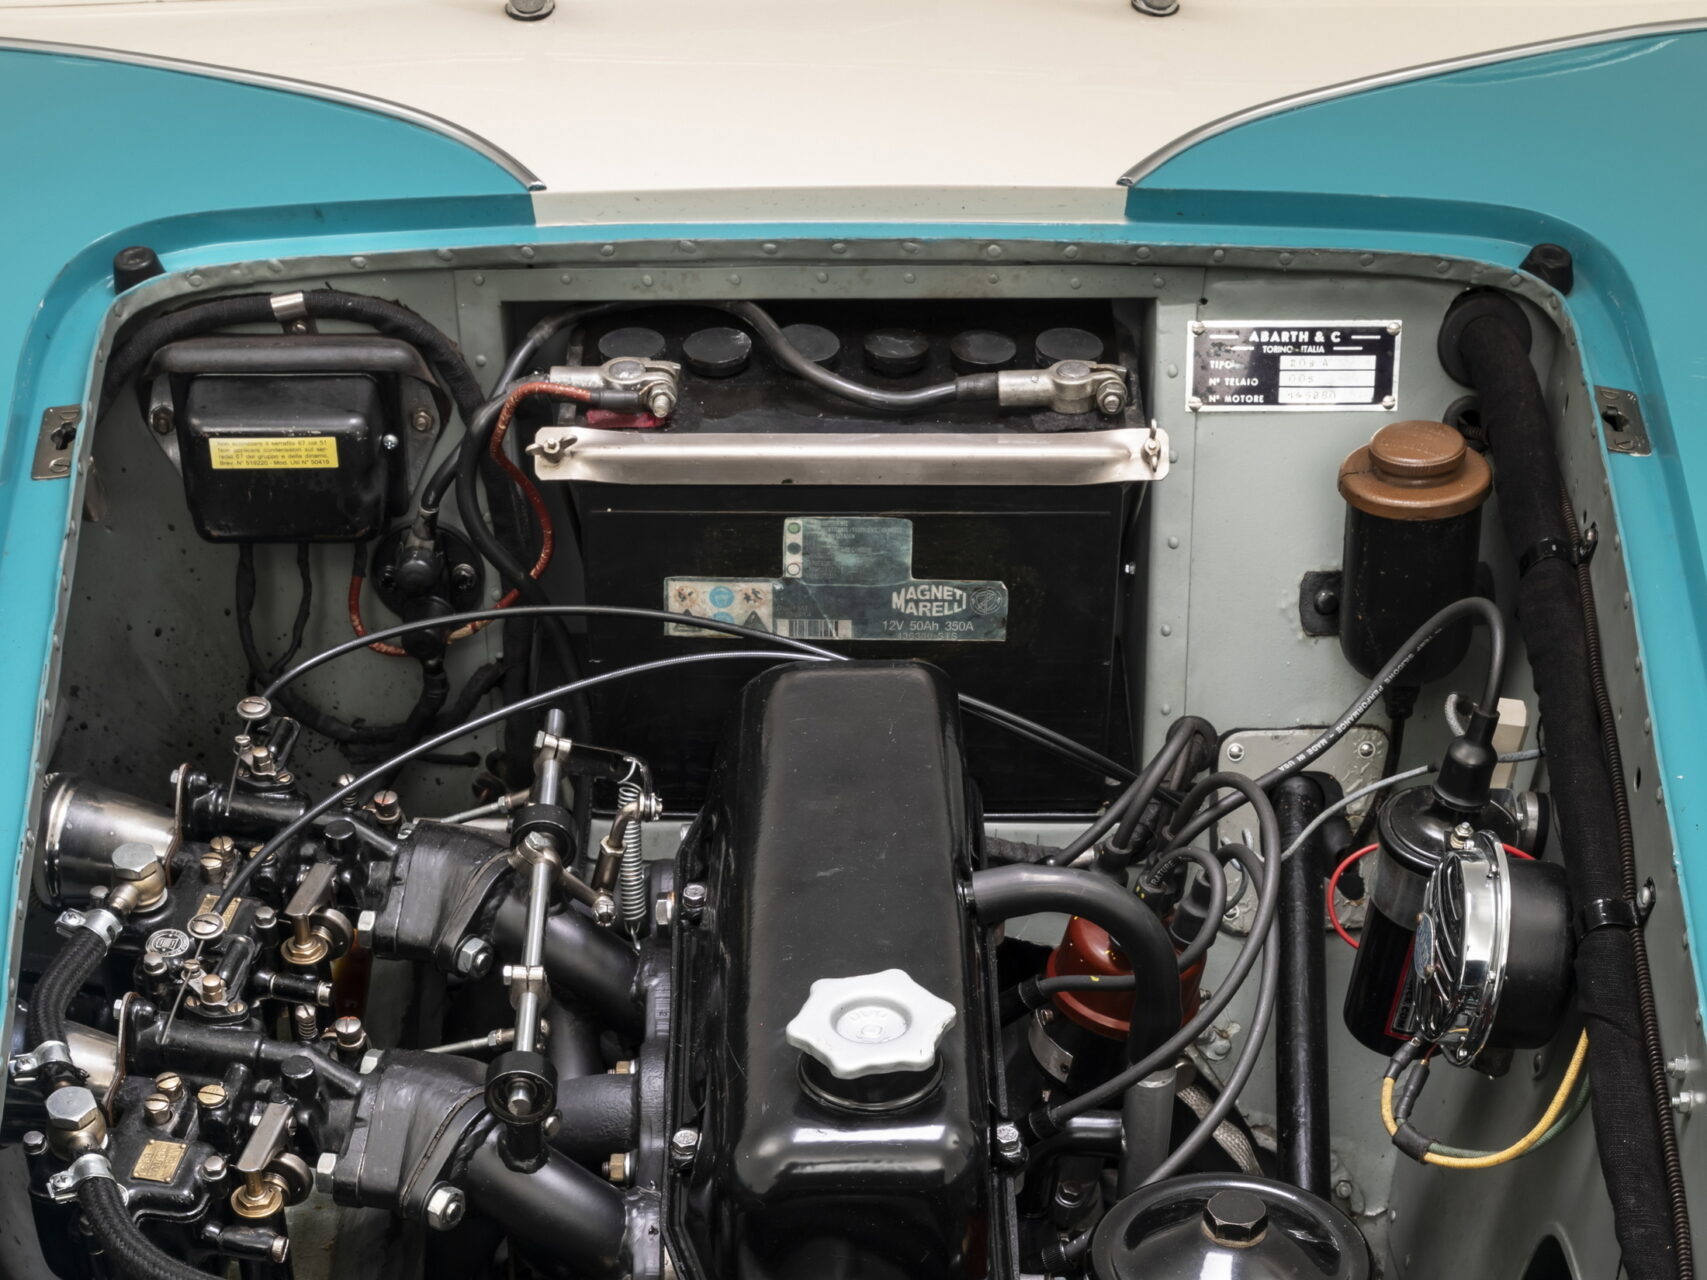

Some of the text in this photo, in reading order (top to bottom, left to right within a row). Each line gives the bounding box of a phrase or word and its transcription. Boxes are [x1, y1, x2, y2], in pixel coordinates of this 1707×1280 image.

[1249, 331, 1342, 343] ABARTH & C
[1262, 345, 1293, 354] TORINO
[1300, 345, 1325, 354] ITALIA
[1210, 360, 1233, 370] TIPO
[1224, 378, 1259, 386] TELAIO
[1224, 394, 1264, 403] MOTORE
[882, 620, 974, 631] 12V 50Ah 350A
[1334, 684, 1384, 735] PERFORMANCE
[1307, 739, 1329, 756] MADE
[1278, 760, 1296, 772] USA
